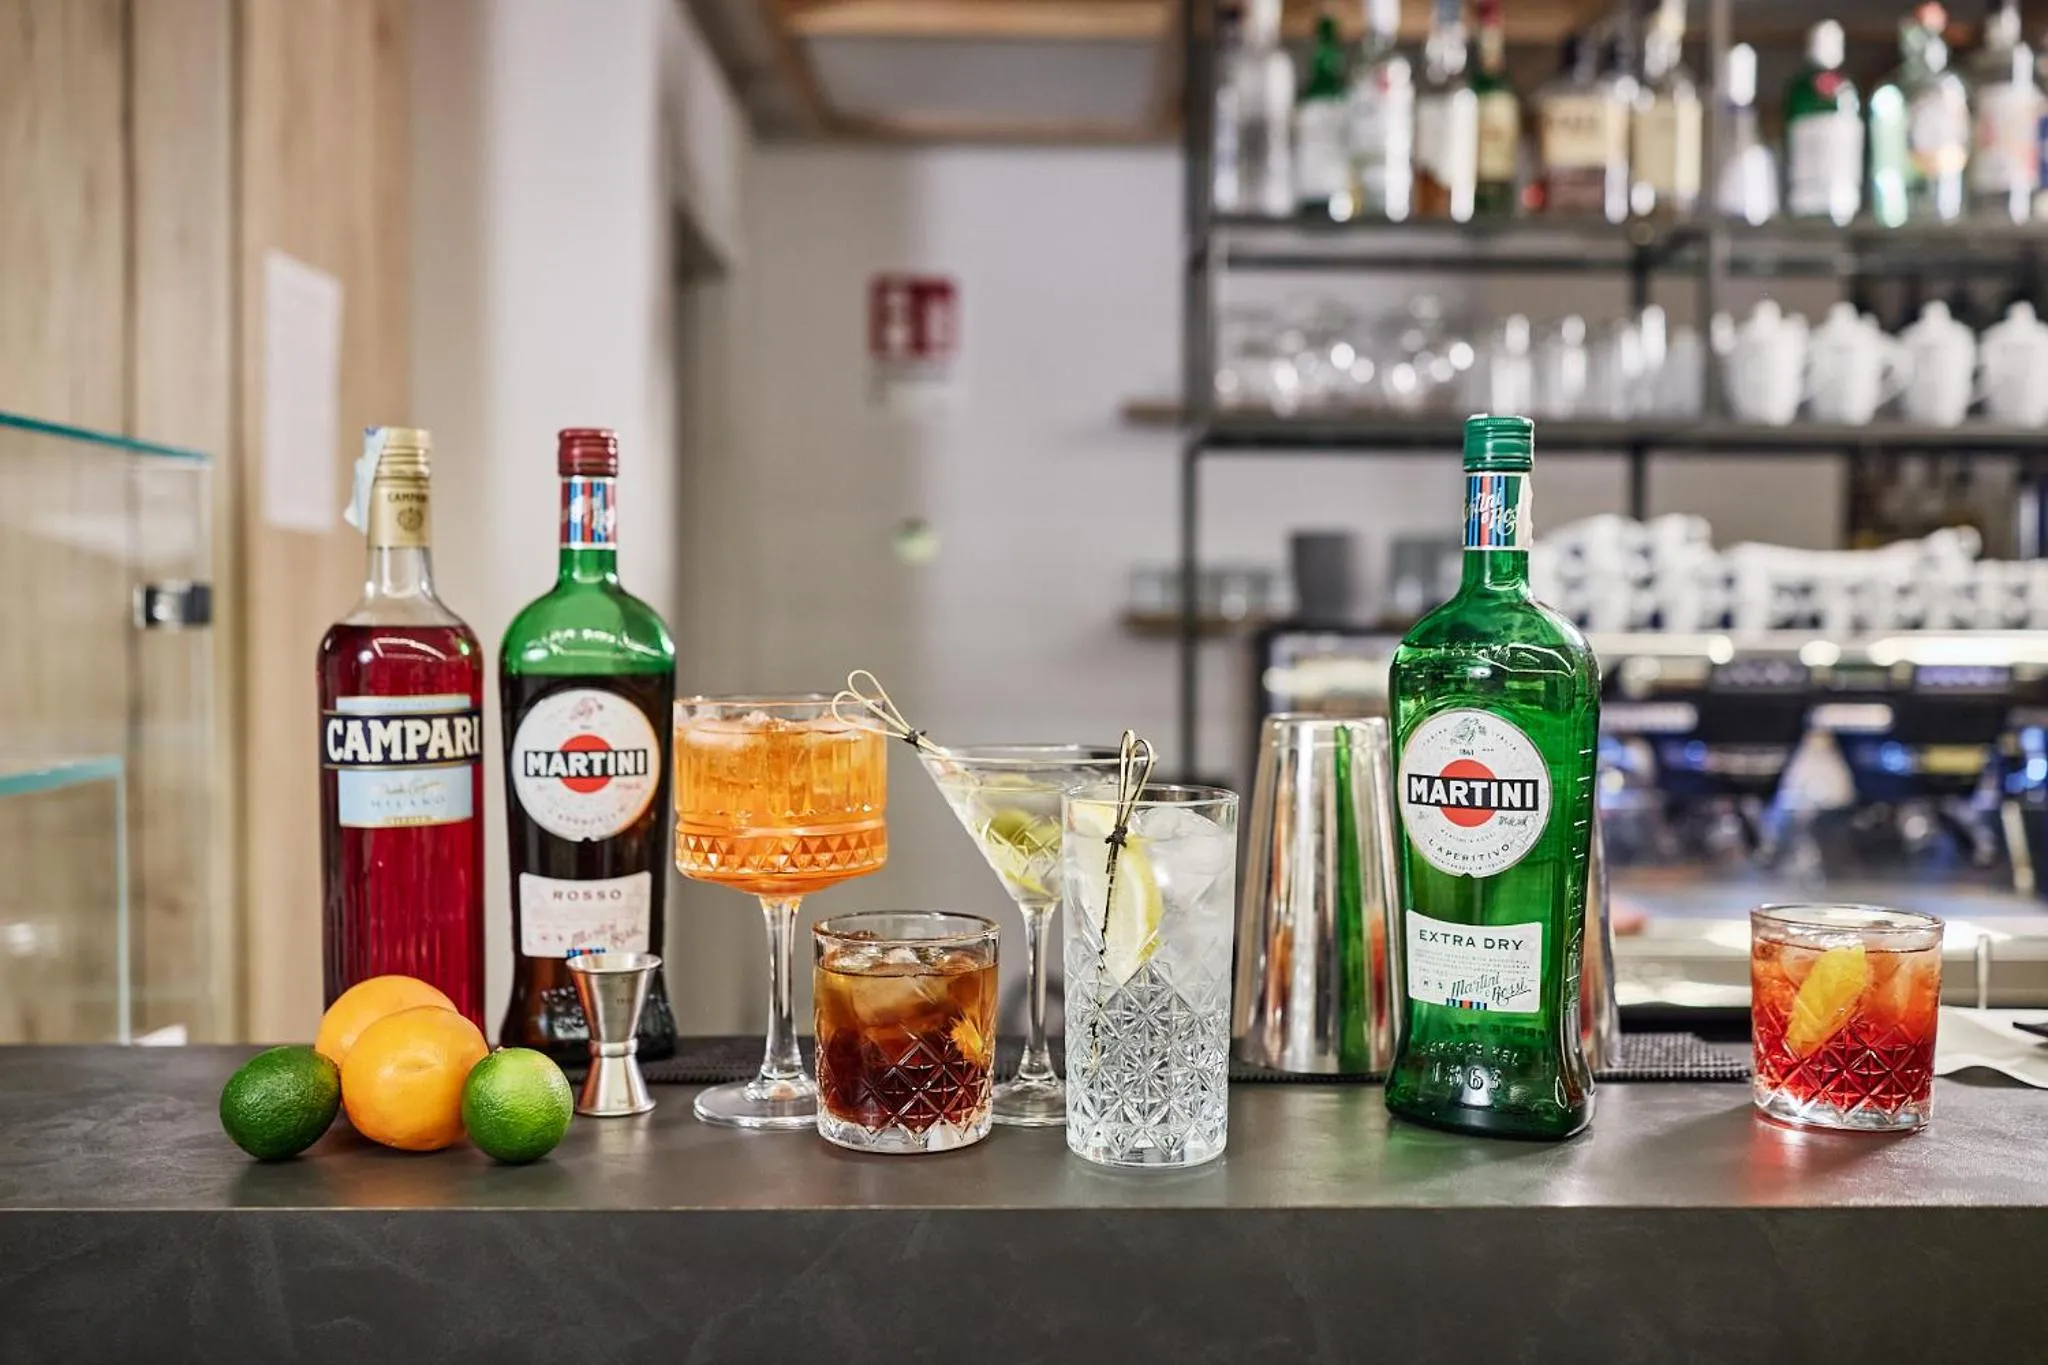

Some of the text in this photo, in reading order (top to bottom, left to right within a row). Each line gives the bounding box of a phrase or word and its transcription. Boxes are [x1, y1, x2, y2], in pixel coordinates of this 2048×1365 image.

[326, 714, 480, 763] CAMPARI
[526, 750, 646, 777] MARTINI
[1410, 776, 1534, 809] MARTINI
[552, 889, 623, 901] ROSSO
[1419, 928, 1525, 951] EXTRA DRY
[1450, 971, 1501, 999] Martini
